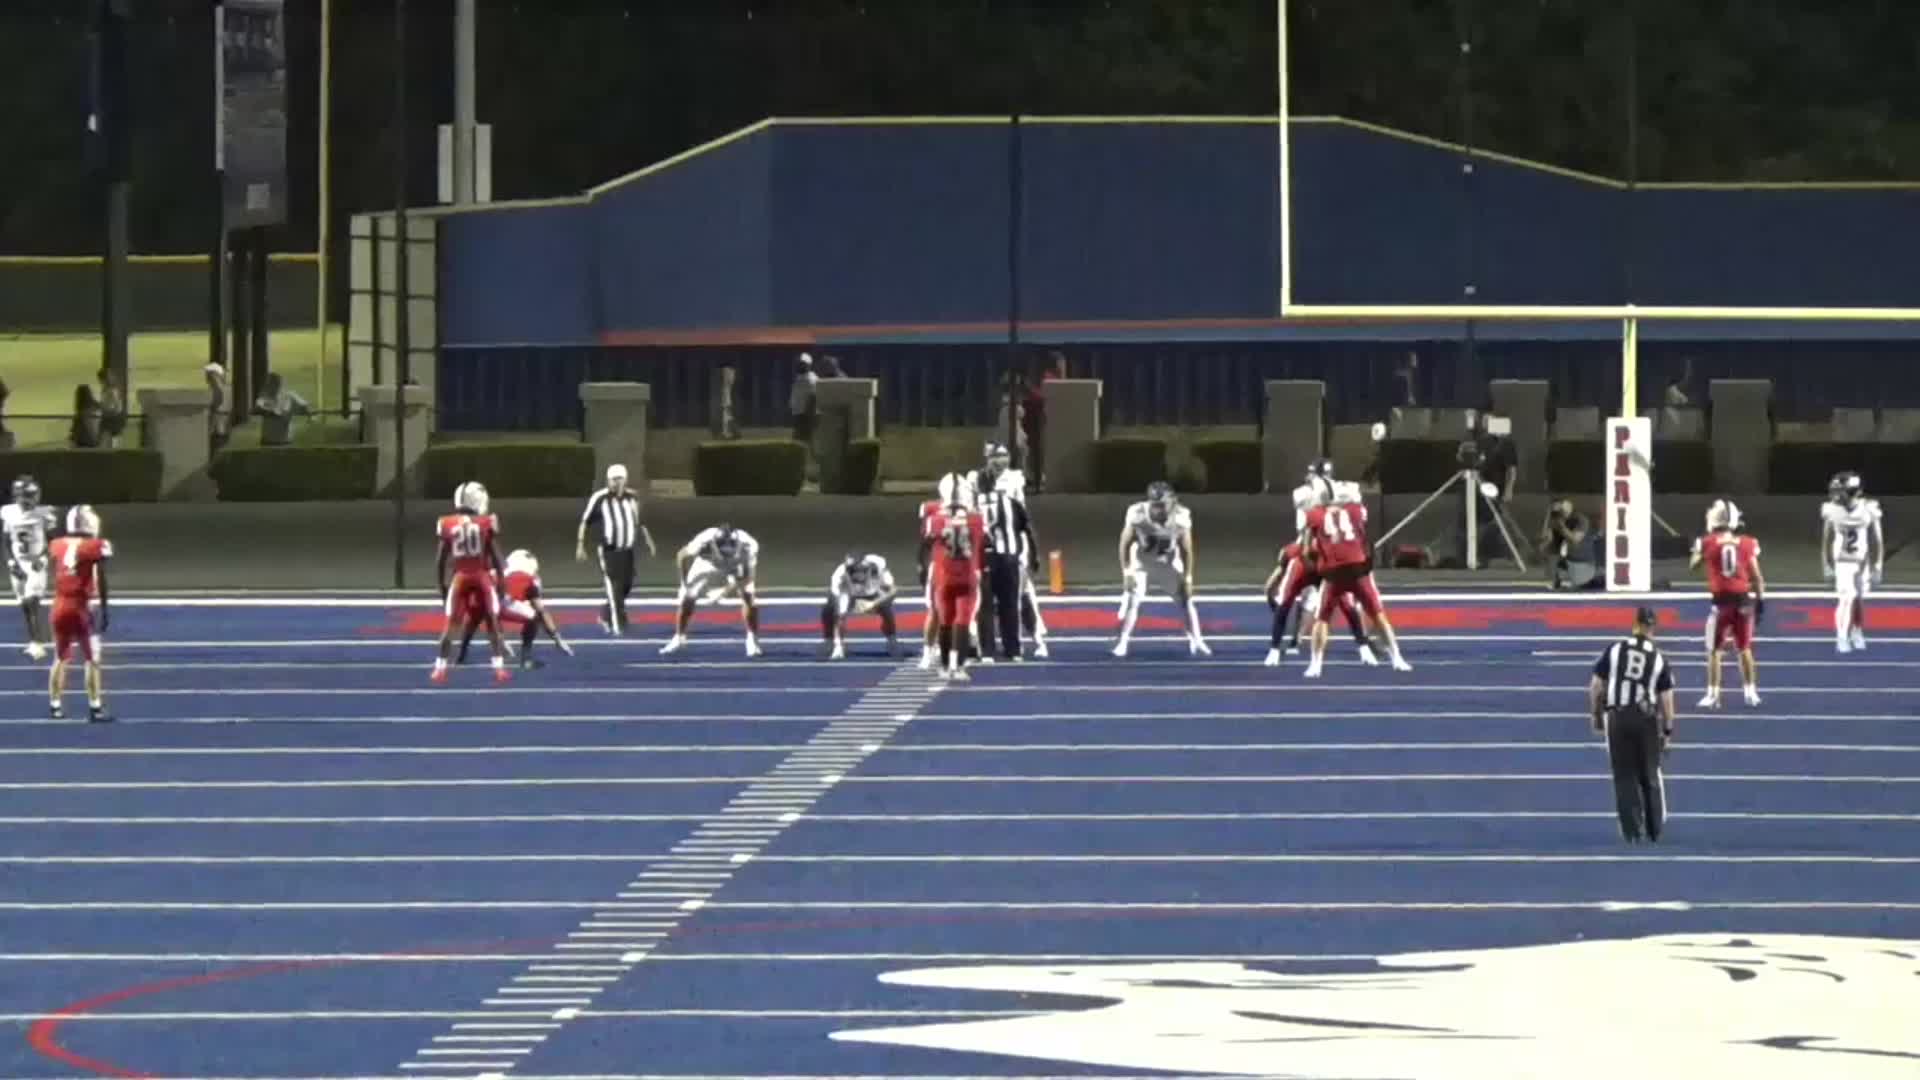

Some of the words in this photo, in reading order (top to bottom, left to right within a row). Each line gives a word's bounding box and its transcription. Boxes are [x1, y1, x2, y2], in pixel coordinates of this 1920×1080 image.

[452, 523, 481, 556] 20
[1324, 508, 1355, 542] 44
[1846, 527, 1859, 551] 2
[1721, 544, 1736, 577] 0
[1626, 650, 1647, 679] B
